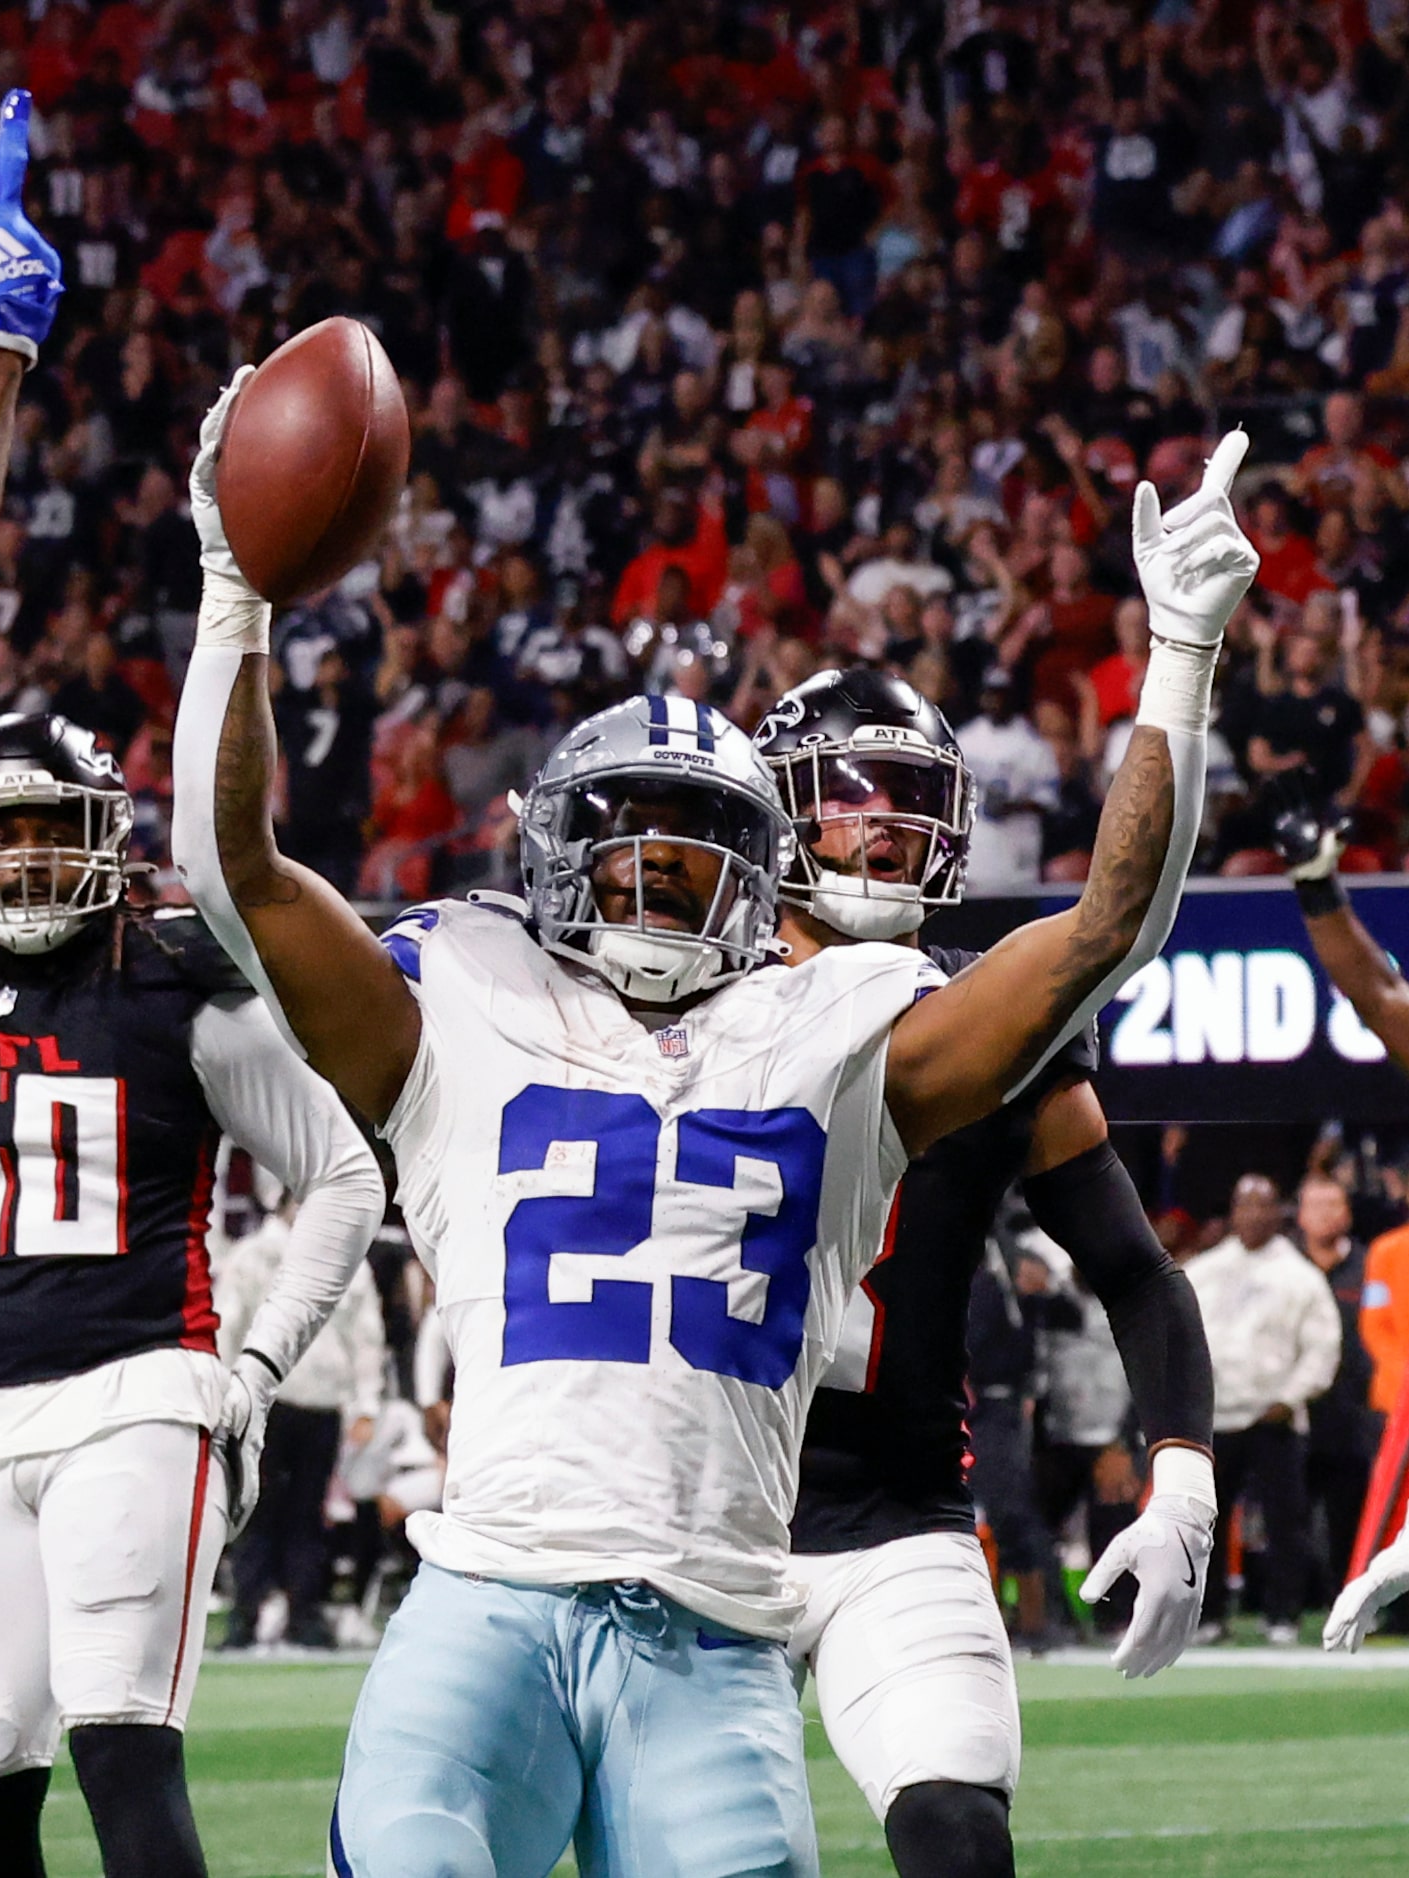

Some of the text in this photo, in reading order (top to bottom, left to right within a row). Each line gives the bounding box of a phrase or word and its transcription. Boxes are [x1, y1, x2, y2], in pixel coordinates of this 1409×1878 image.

[305, 709, 340, 766] 7
[654, 751, 714, 767] COWBOYS
[873, 727, 909, 741] ATL
[1110, 949, 1318, 1066] 2ND
[498, 1083, 828, 1391] 23
